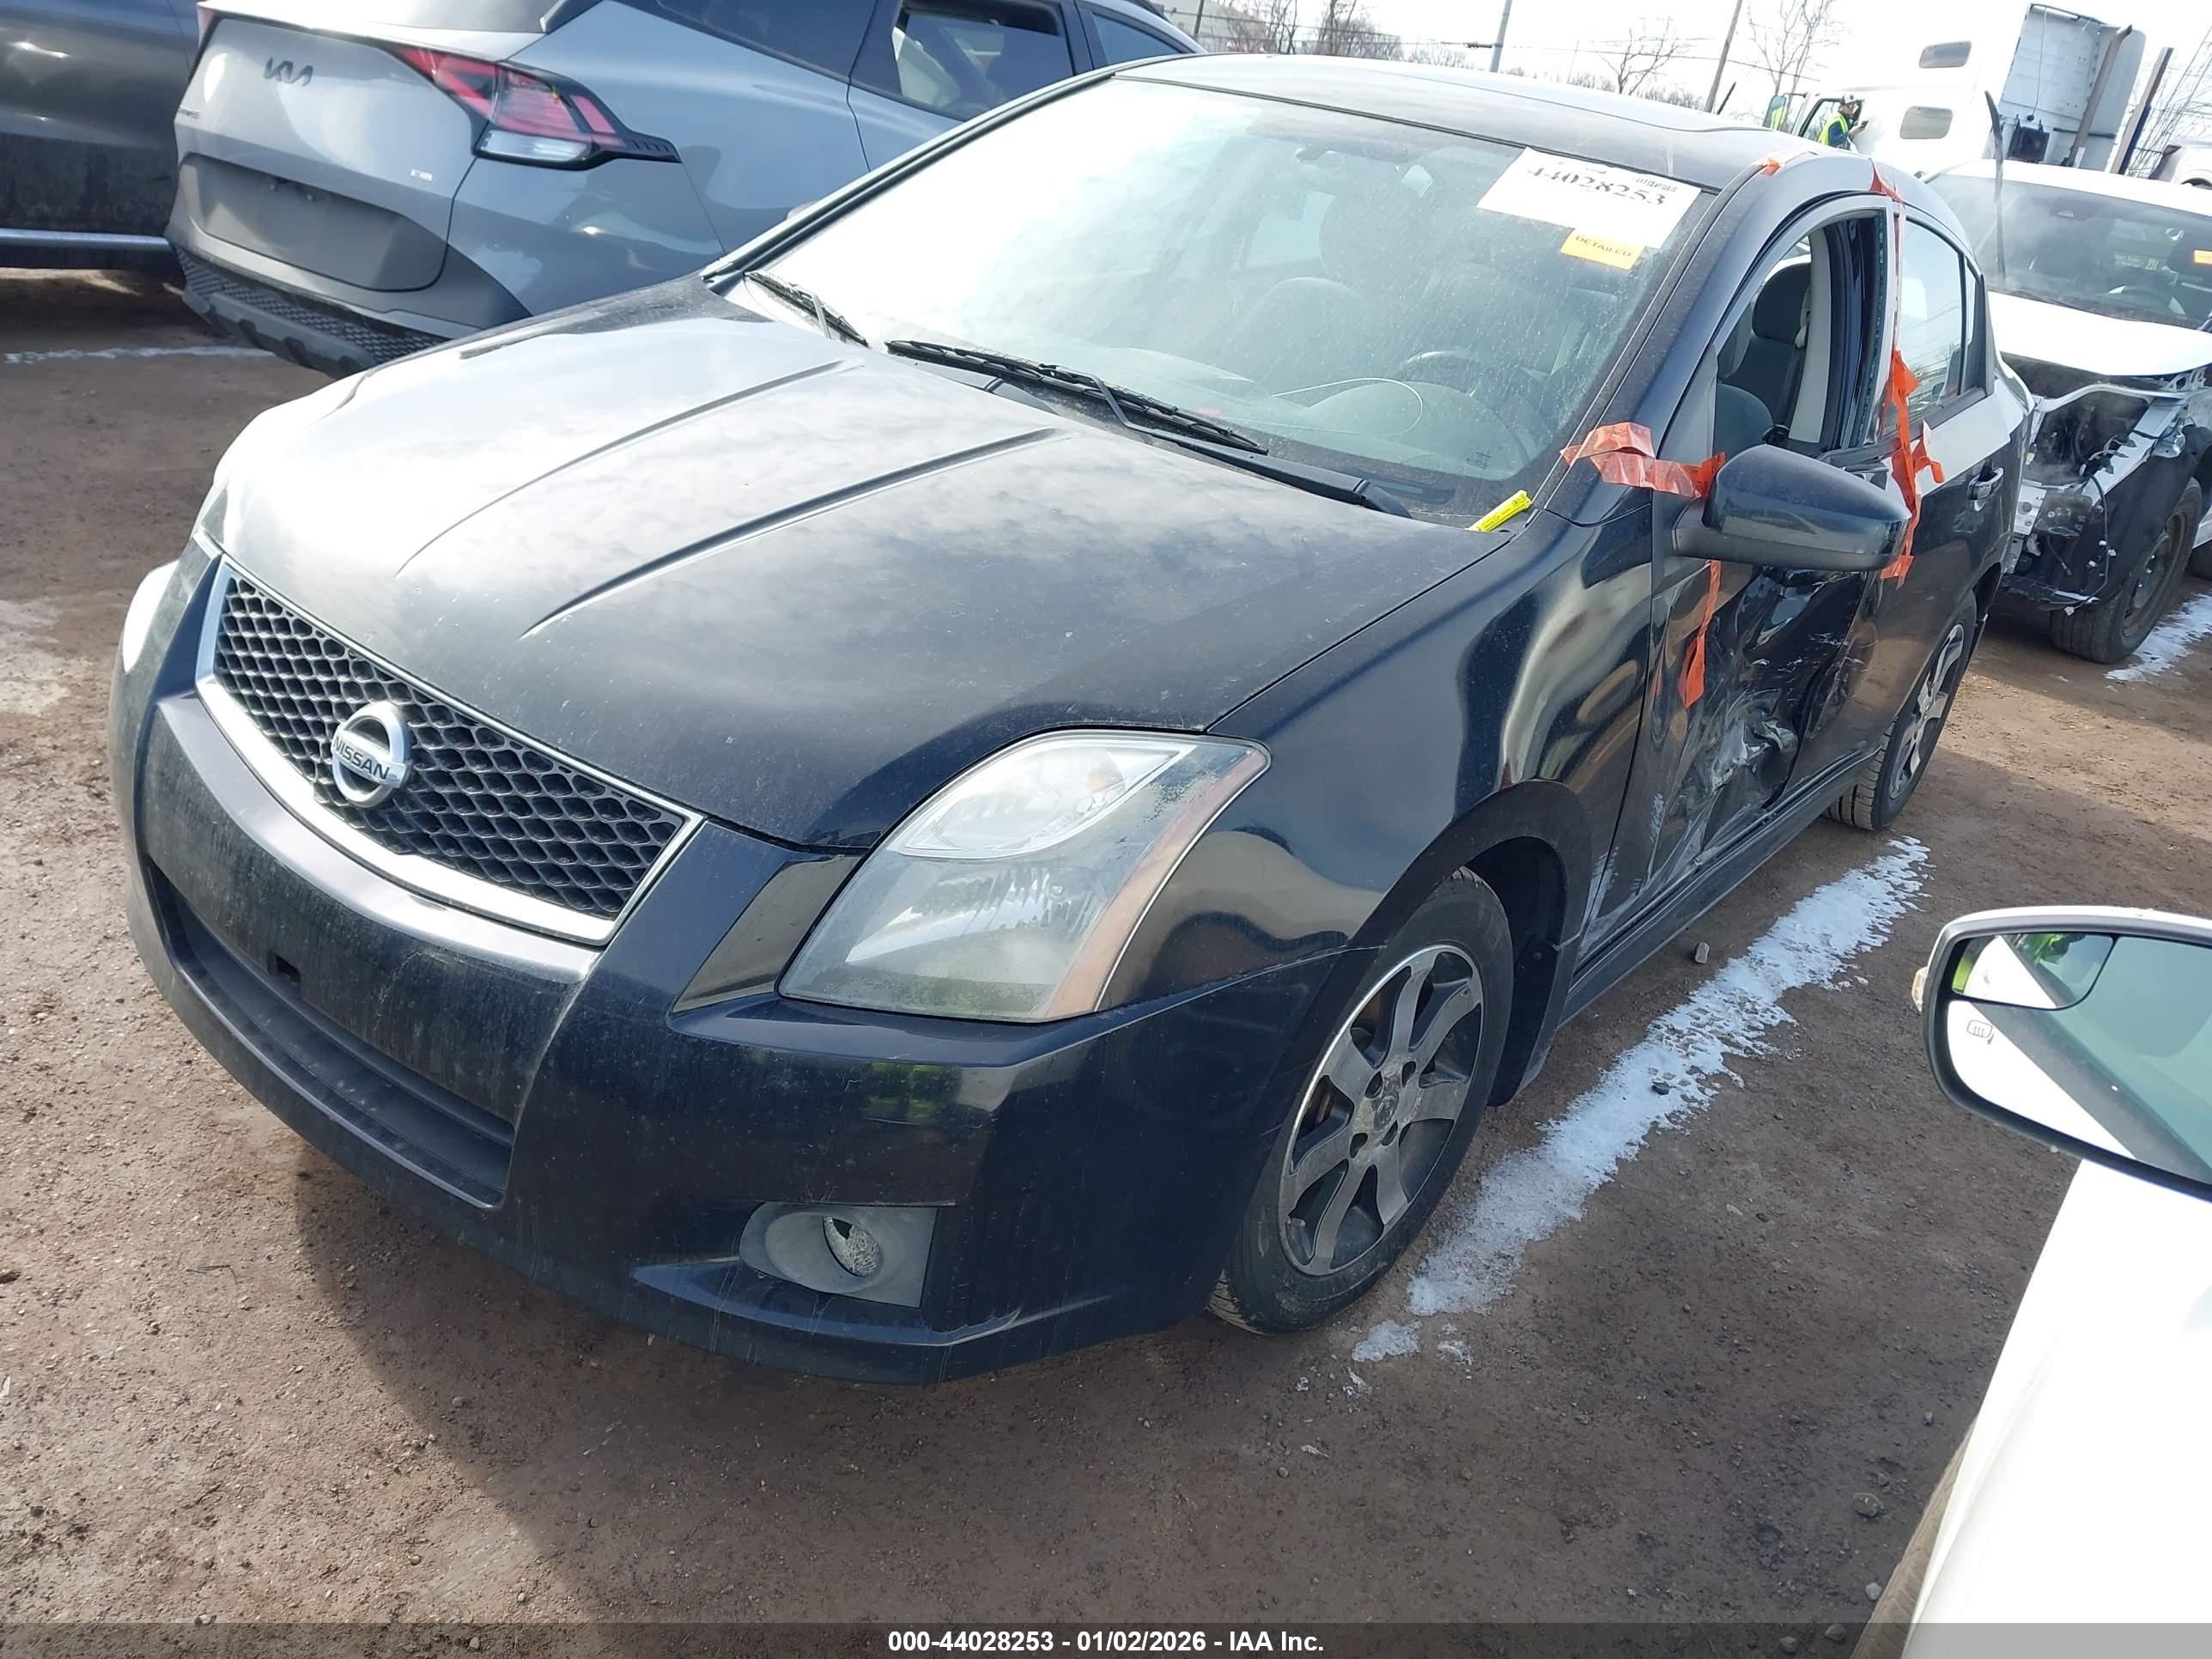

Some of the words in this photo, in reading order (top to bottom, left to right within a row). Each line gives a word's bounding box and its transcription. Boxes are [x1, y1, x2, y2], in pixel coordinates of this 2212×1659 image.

[263, 58, 313, 87] KIA
[1528, 167, 1666, 205] 44028253
[333, 735, 390, 780] NISSAN
